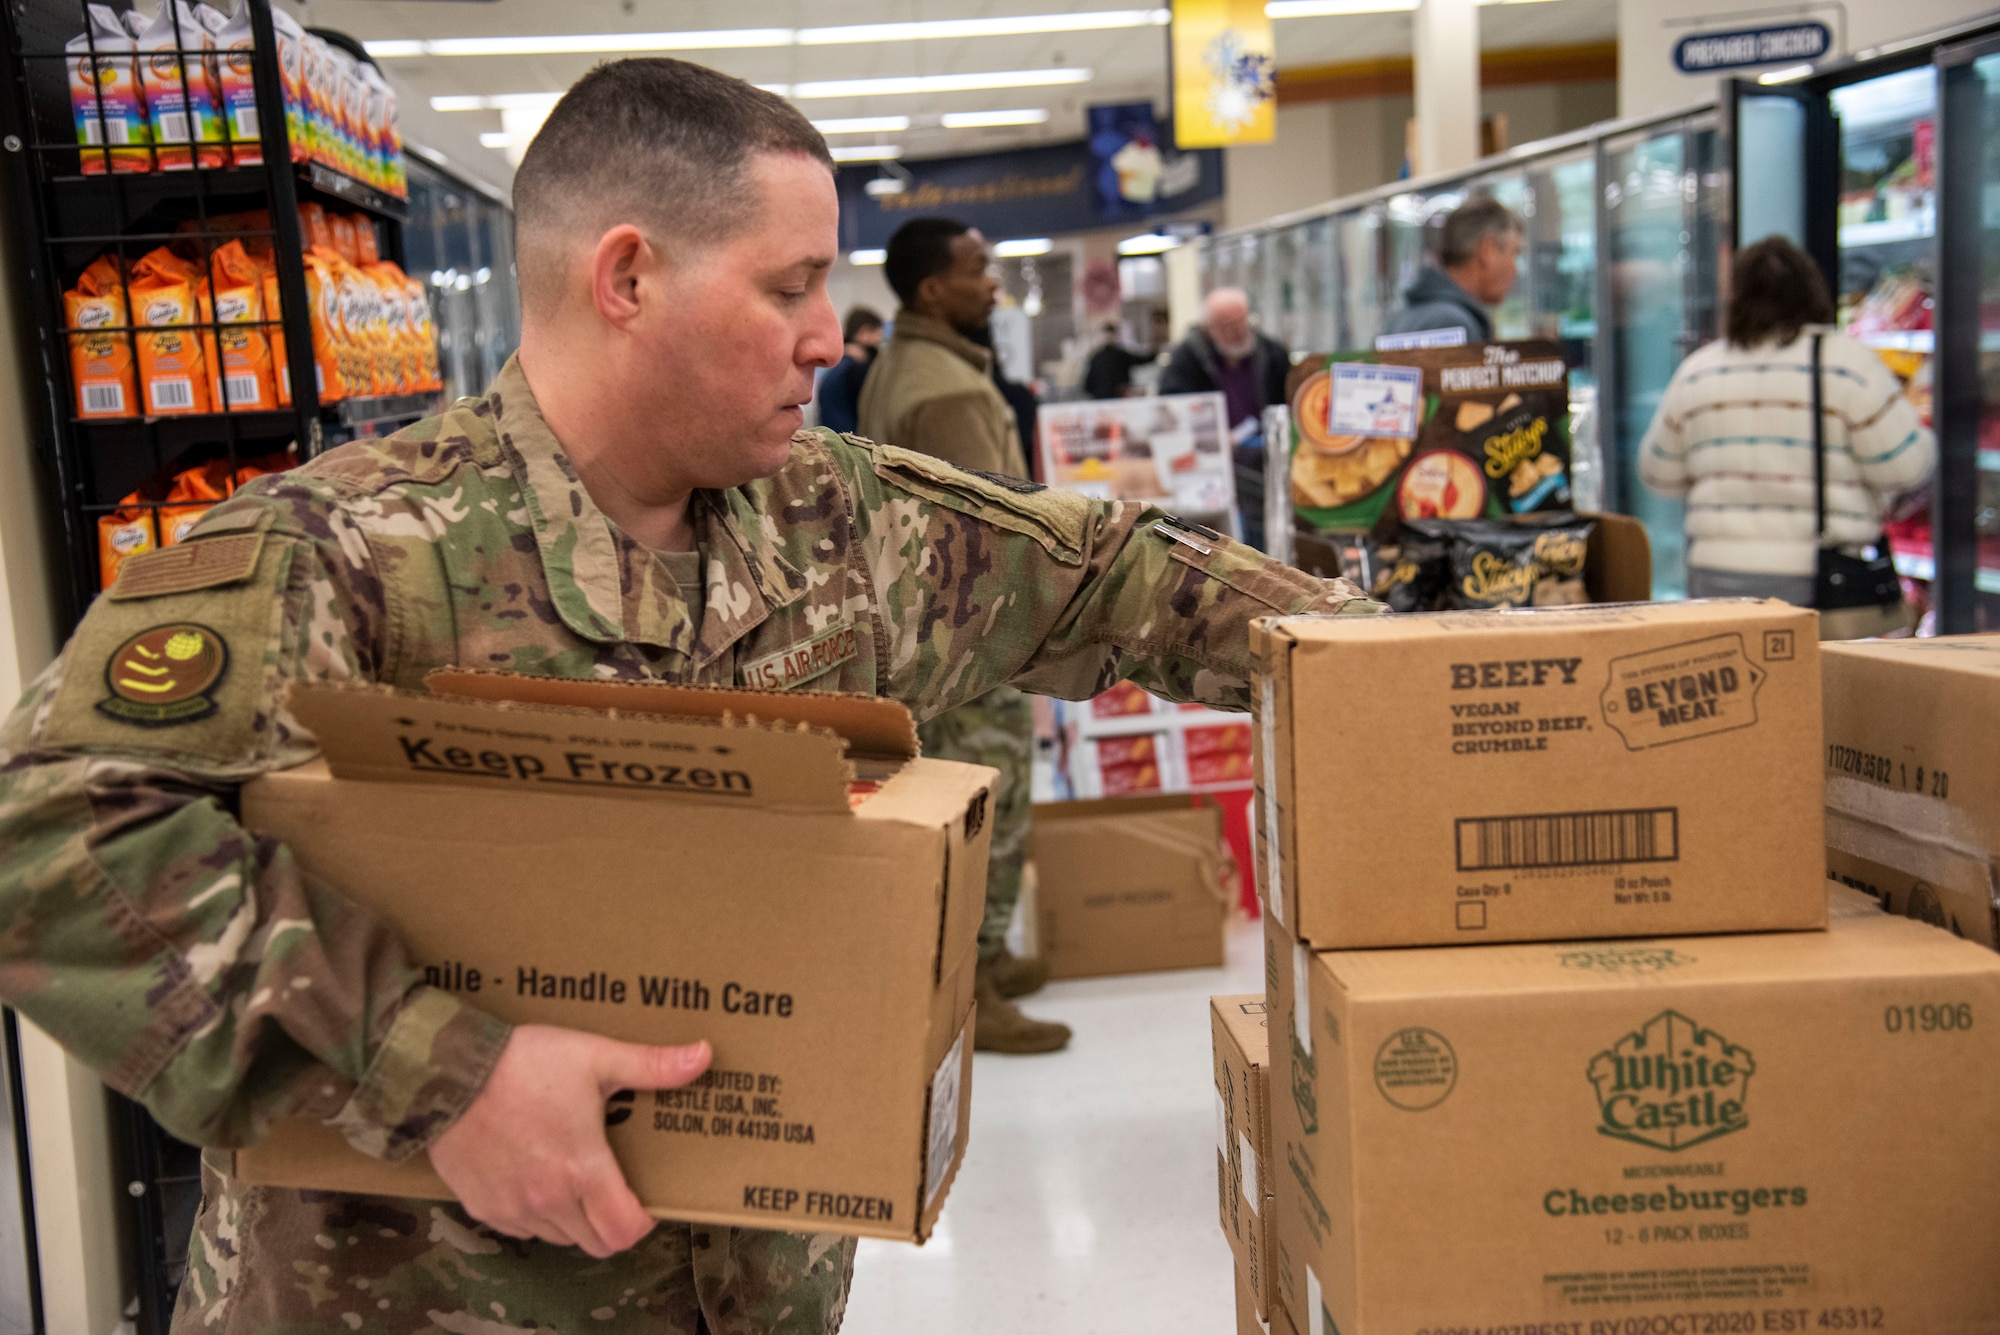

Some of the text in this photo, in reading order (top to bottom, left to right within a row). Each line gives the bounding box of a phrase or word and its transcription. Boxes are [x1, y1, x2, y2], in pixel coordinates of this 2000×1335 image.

[1440, 366, 1499, 391] PERFECT
[1501, 360, 1566, 387] MATCHUP
[784, 649, 813, 684] AIR
[811, 629, 856, 672] FORCE
[1450, 657, 1583, 690] BEEFY
[1625, 666, 1739, 715] BEYOND
[1450, 701, 1521, 717] VEGAN
[1452, 719, 1535, 737] BEYOND
[1452, 737, 1549, 755] CRUMBLE
[398, 735, 753, 791] Keep Frozen
[517, 965, 627, 1004] Handle
[640, 975, 710, 1011] With
[722, 982, 794, 1018] Care
[1884, 1002, 1974, 1034] 01906
[758, 1073, 782, 1095] BY:
[1611, 1050, 1736, 1098] White
[714, 1094, 750, 1117] USA,
[752, 1097, 783, 1118] INC.
[1603, 1090, 1743, 1131] Castle
[653, 1111, 815, 1144] SOLON, OH 44139 USA
[743, 1185, 894, 1222] KEEP FROZEN
[1543, 1184, 1809, 1217] Cheeseburgers
[1604, 1228, 1624, 1246] 12
[1653, 1224, 1694, 1242] PACK
[1698, 1222, 1750, 1241] BOXES
[1763, 1308, 1811, 1332] EST
[1817, 1306, 1885, 1330] 45312
